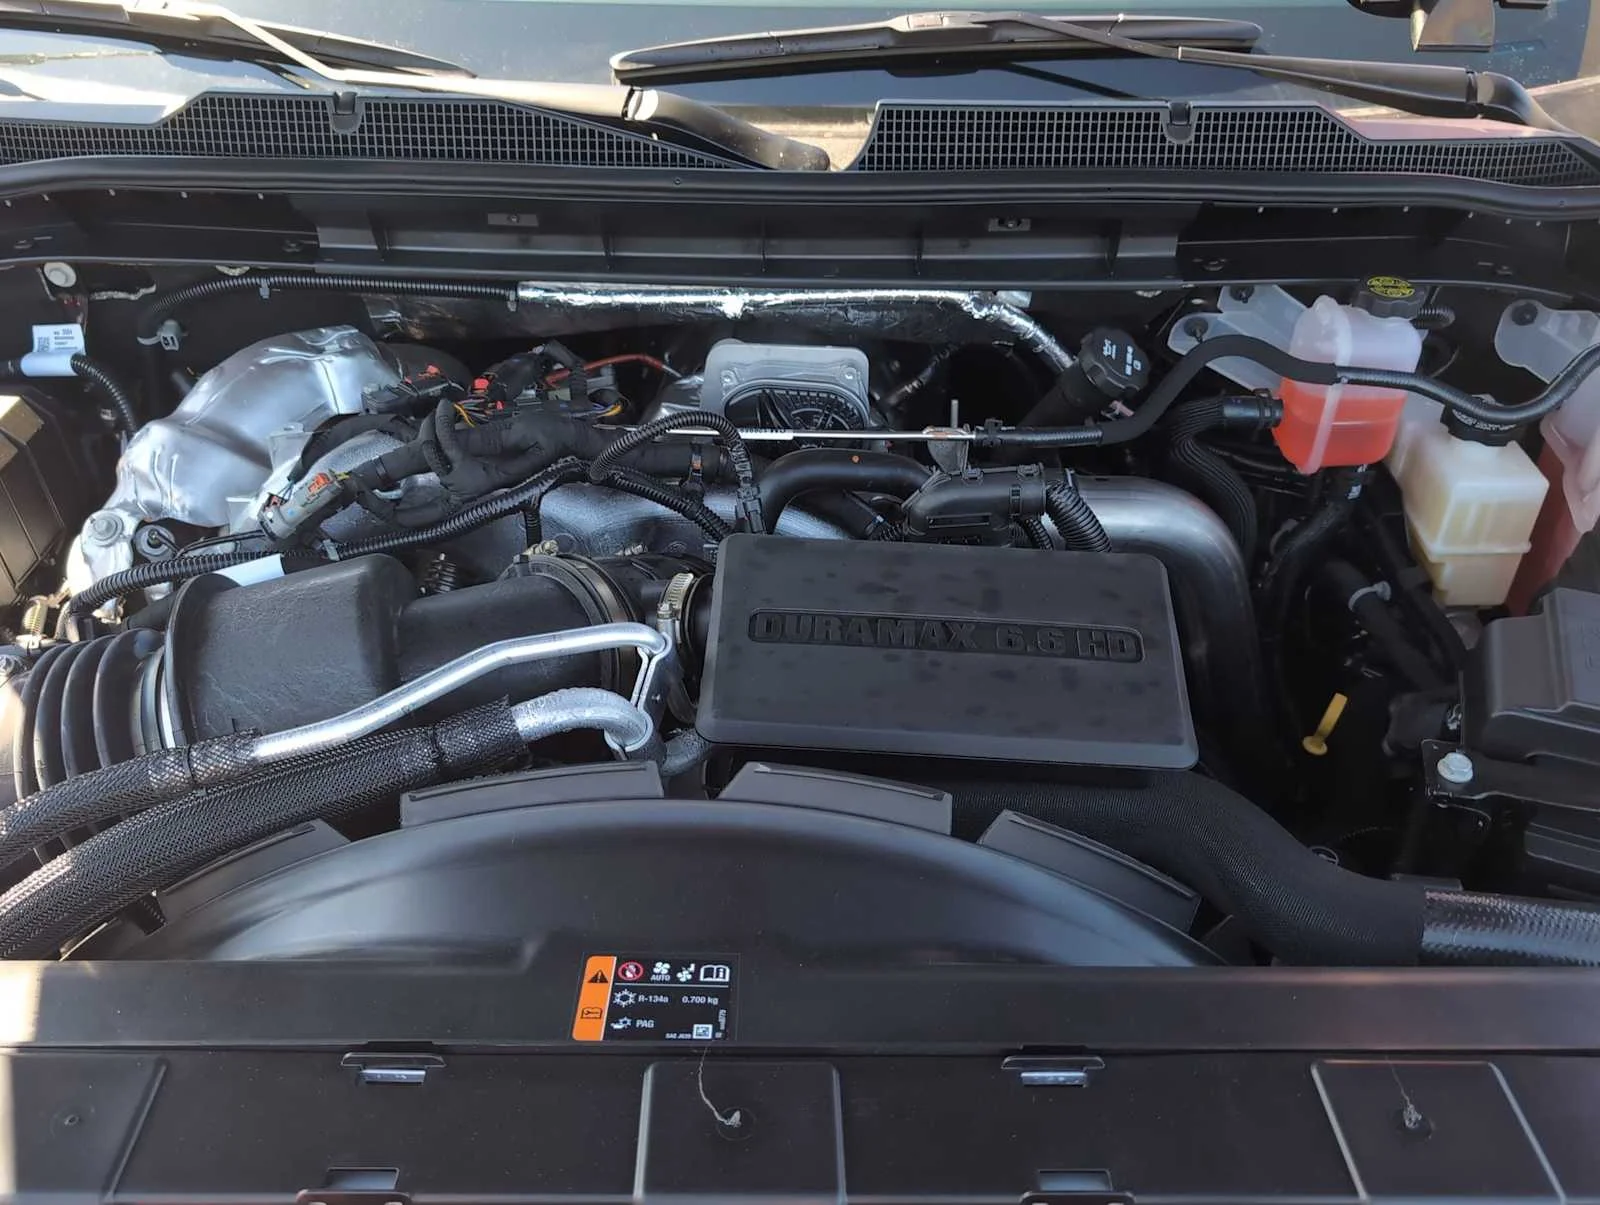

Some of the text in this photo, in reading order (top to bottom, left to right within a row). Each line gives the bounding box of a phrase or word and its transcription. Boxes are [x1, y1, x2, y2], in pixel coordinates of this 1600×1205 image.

[755, 613, 1138, 659] DURAMAX 6.6 HD
[650, 974, 671, 982] AUTO
[638, 994, 719, 1006] R-134a 0.700 kg
[635, 1019, 655, 1029] PAG
